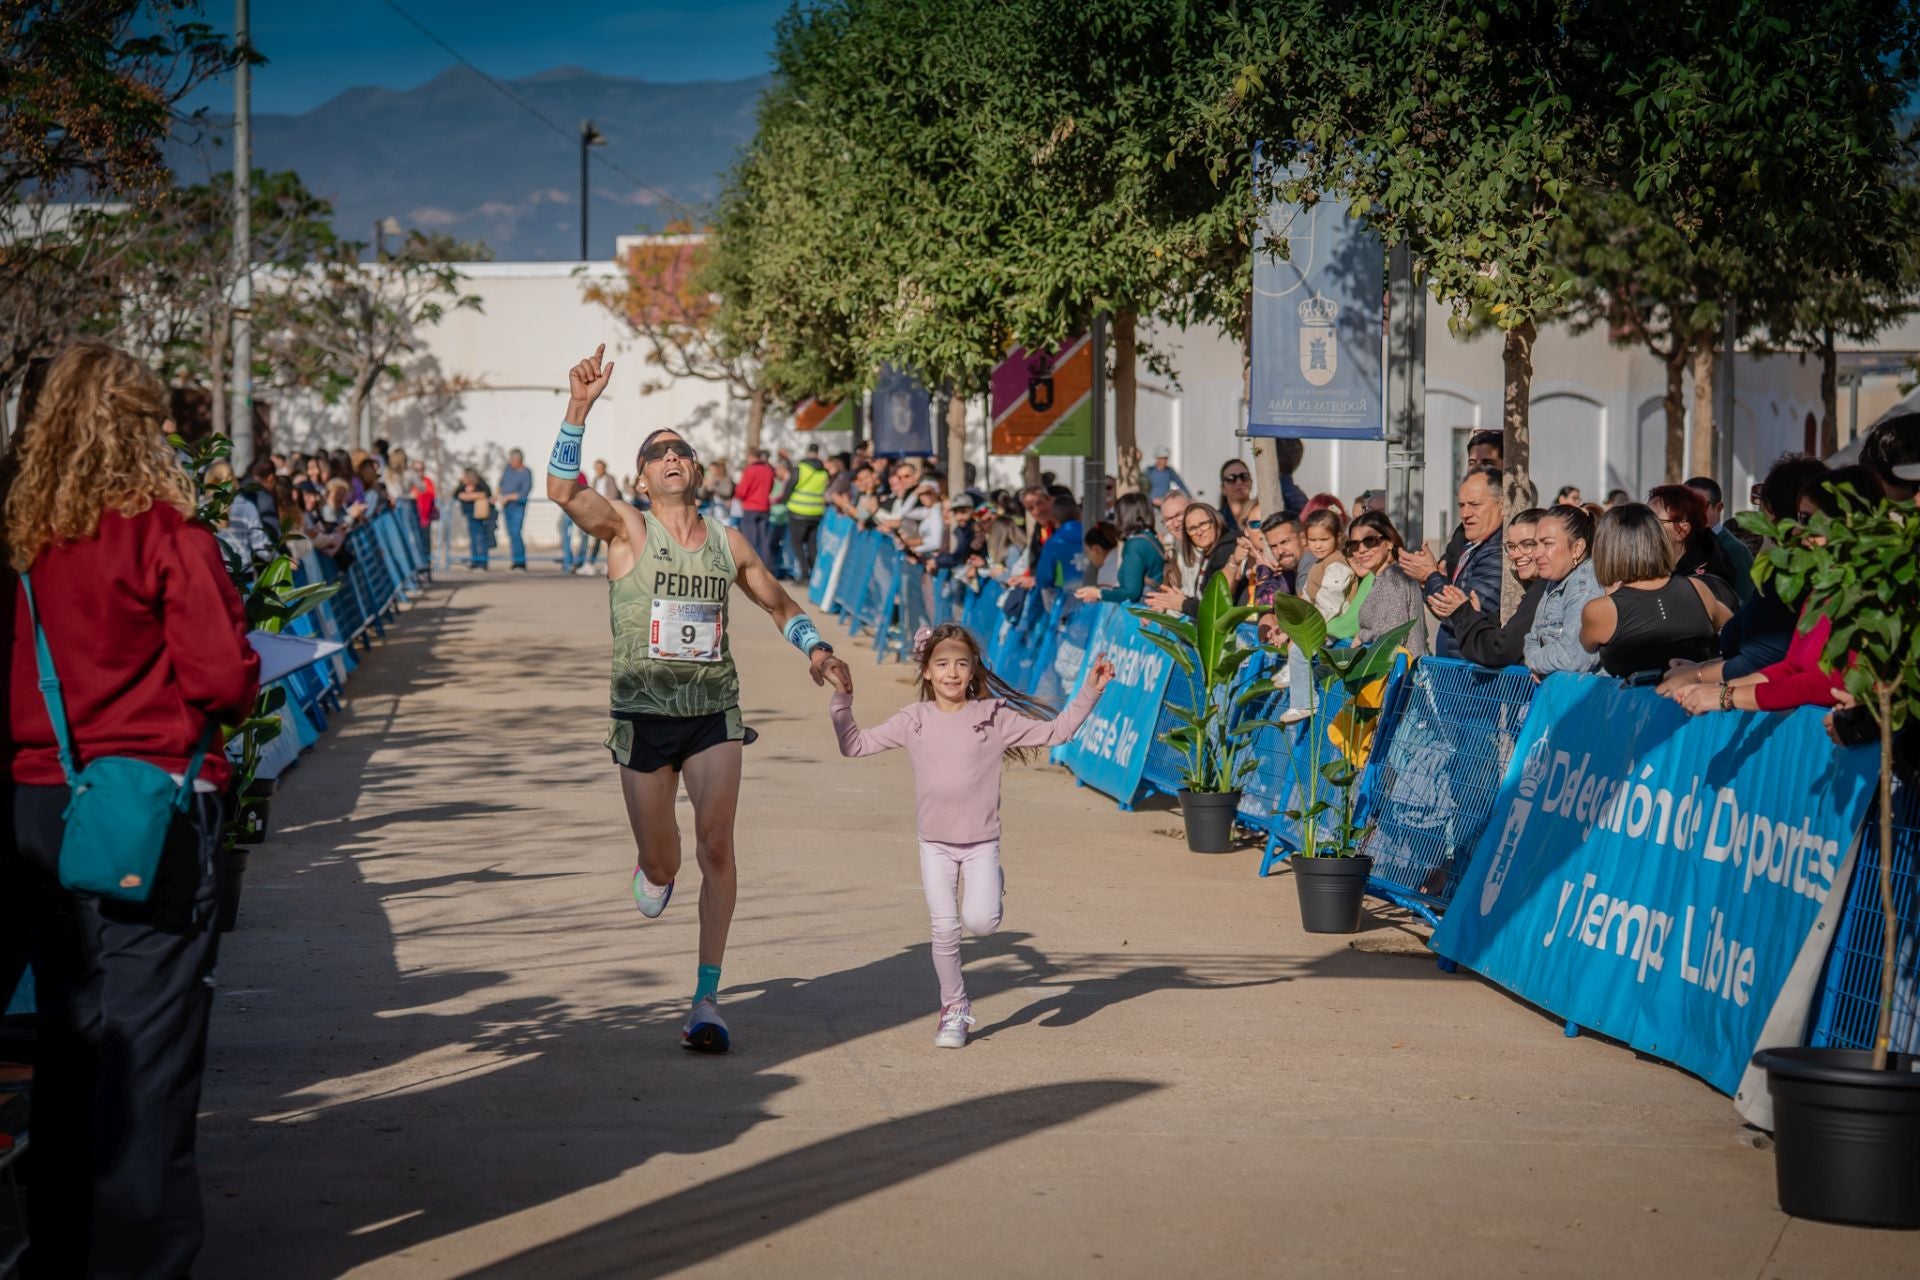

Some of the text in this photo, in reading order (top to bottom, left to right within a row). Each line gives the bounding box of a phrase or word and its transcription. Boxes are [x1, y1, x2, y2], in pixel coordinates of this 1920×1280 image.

[654, 571, 727, 601] PEDRITO
[681, 625, 696, 644] 9
[1703, 787, 1838, 905] Deportes
[1543, 880, 1575, 947] y
[1680, 904, 1756, 1008] Libre
